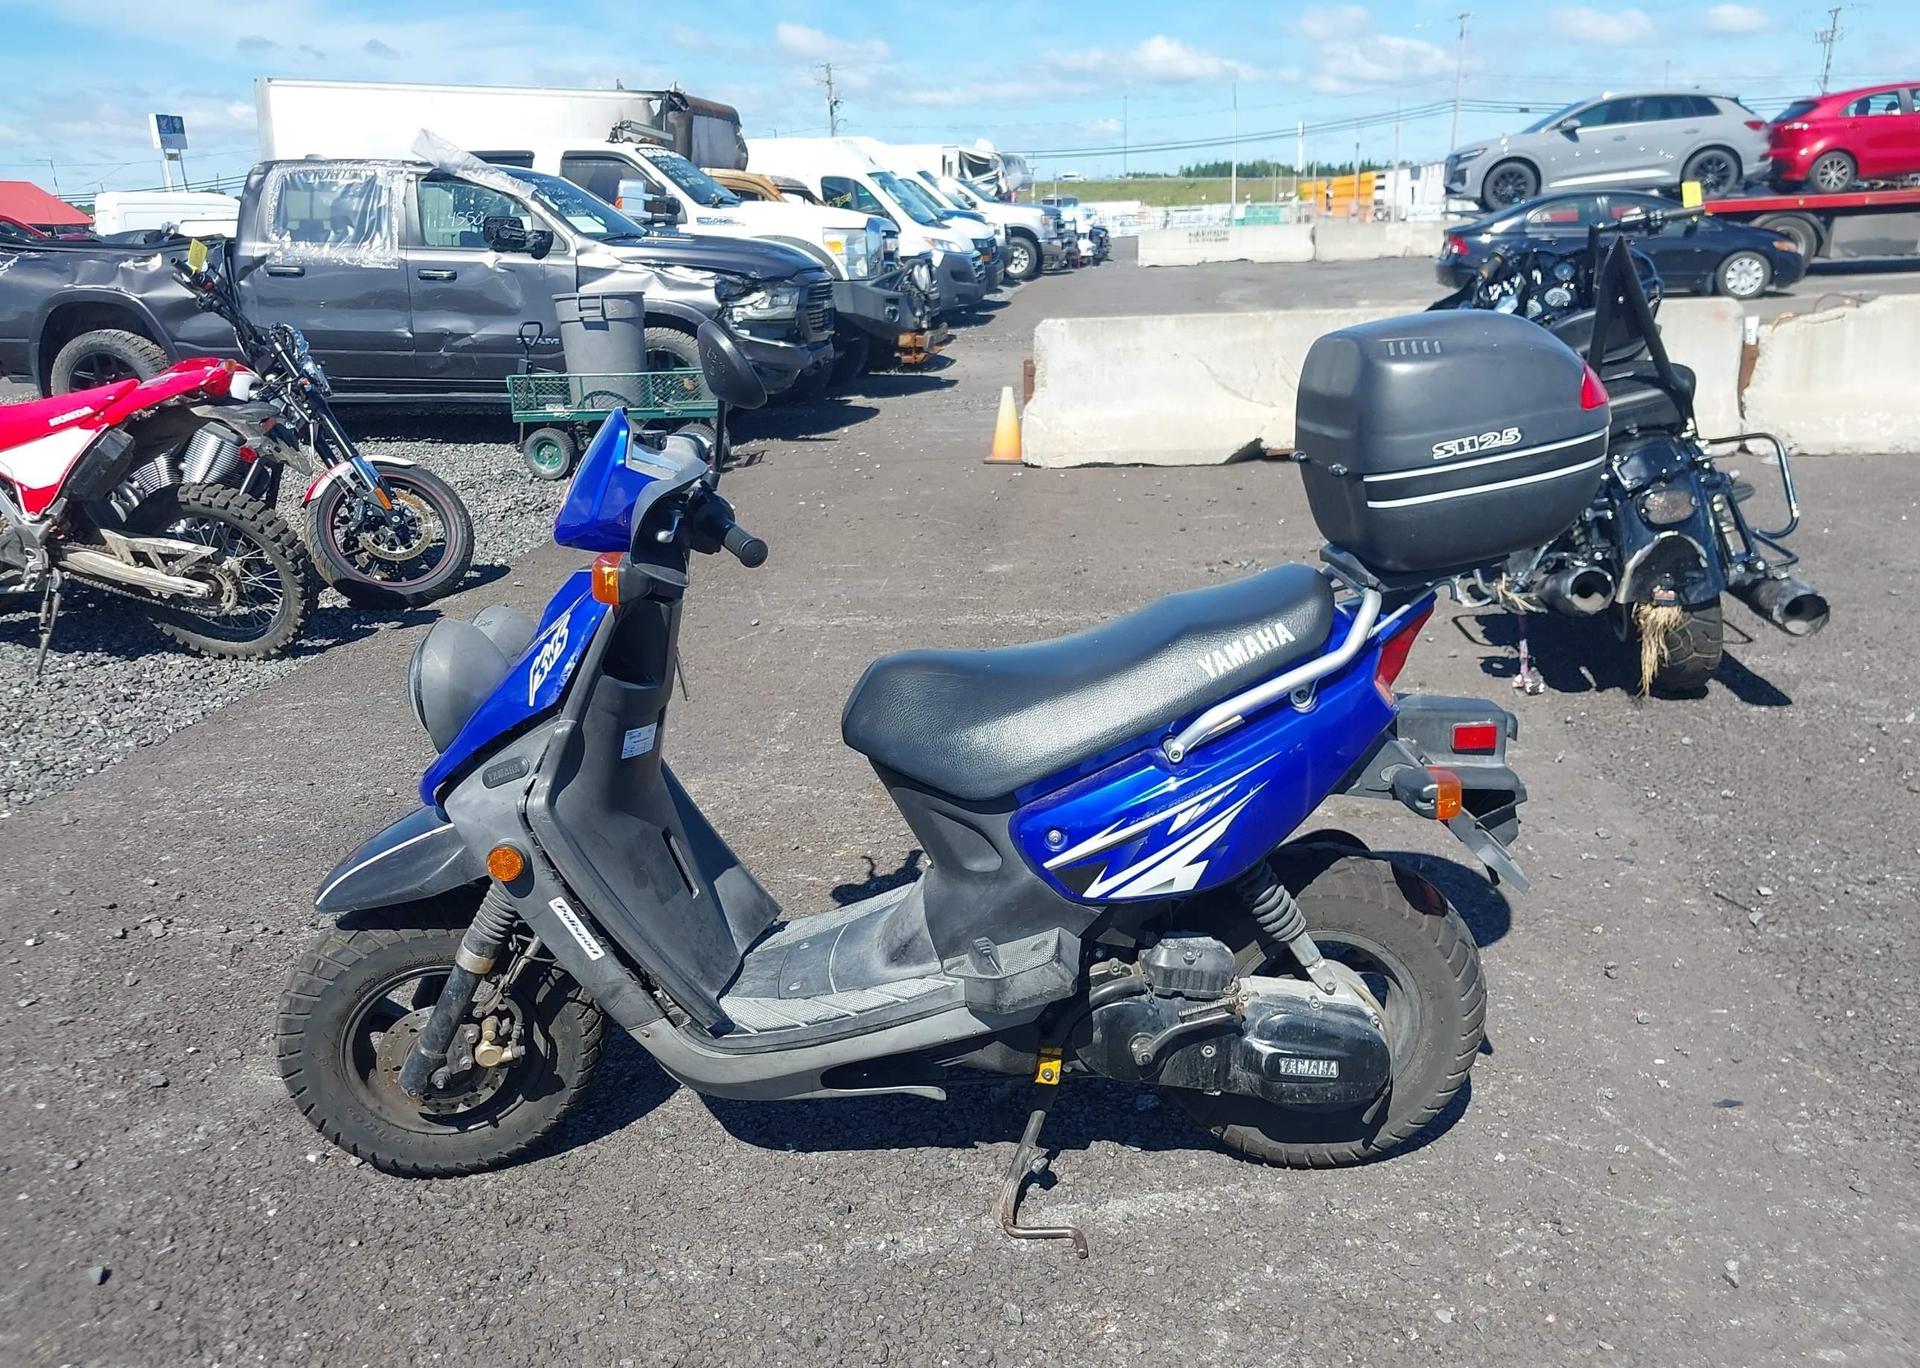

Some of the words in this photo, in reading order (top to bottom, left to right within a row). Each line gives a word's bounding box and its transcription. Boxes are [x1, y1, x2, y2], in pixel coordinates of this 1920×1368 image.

[1432, 427, 1522, 460] SH25
[1196, 622, 1296, 679] YAMAHA
[487, 764, 520, 782] YAMAHA
[555, 903, 601, 955] Polisport
[1279, 1058, 1338, 1077] YAMAHA
